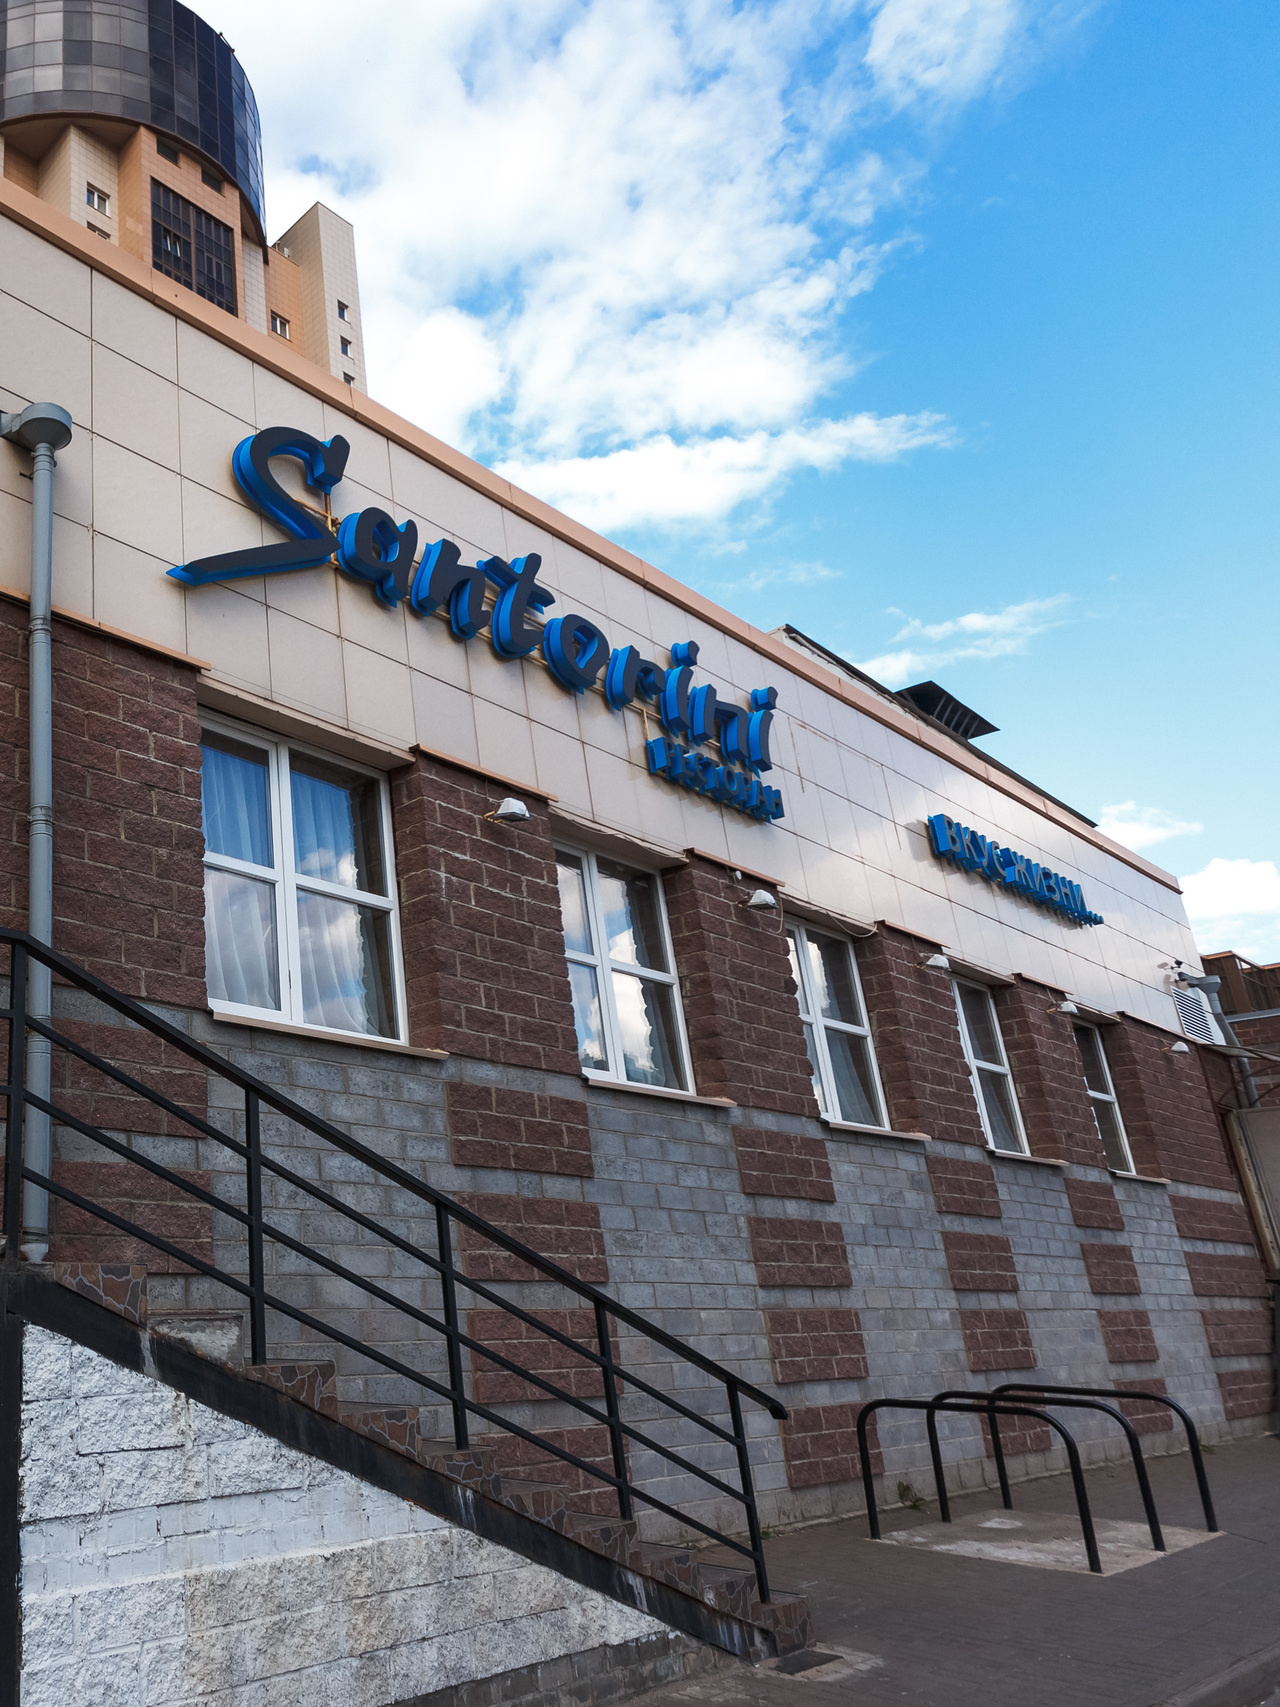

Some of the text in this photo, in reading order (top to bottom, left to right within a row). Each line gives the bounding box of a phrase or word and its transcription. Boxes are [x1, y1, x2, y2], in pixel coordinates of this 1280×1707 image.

[167, 426, 776, 773] Santorini
[646, 736, 785, 823] РЕСТОРАН
[928, 813, 1008, 882] ВКУС
